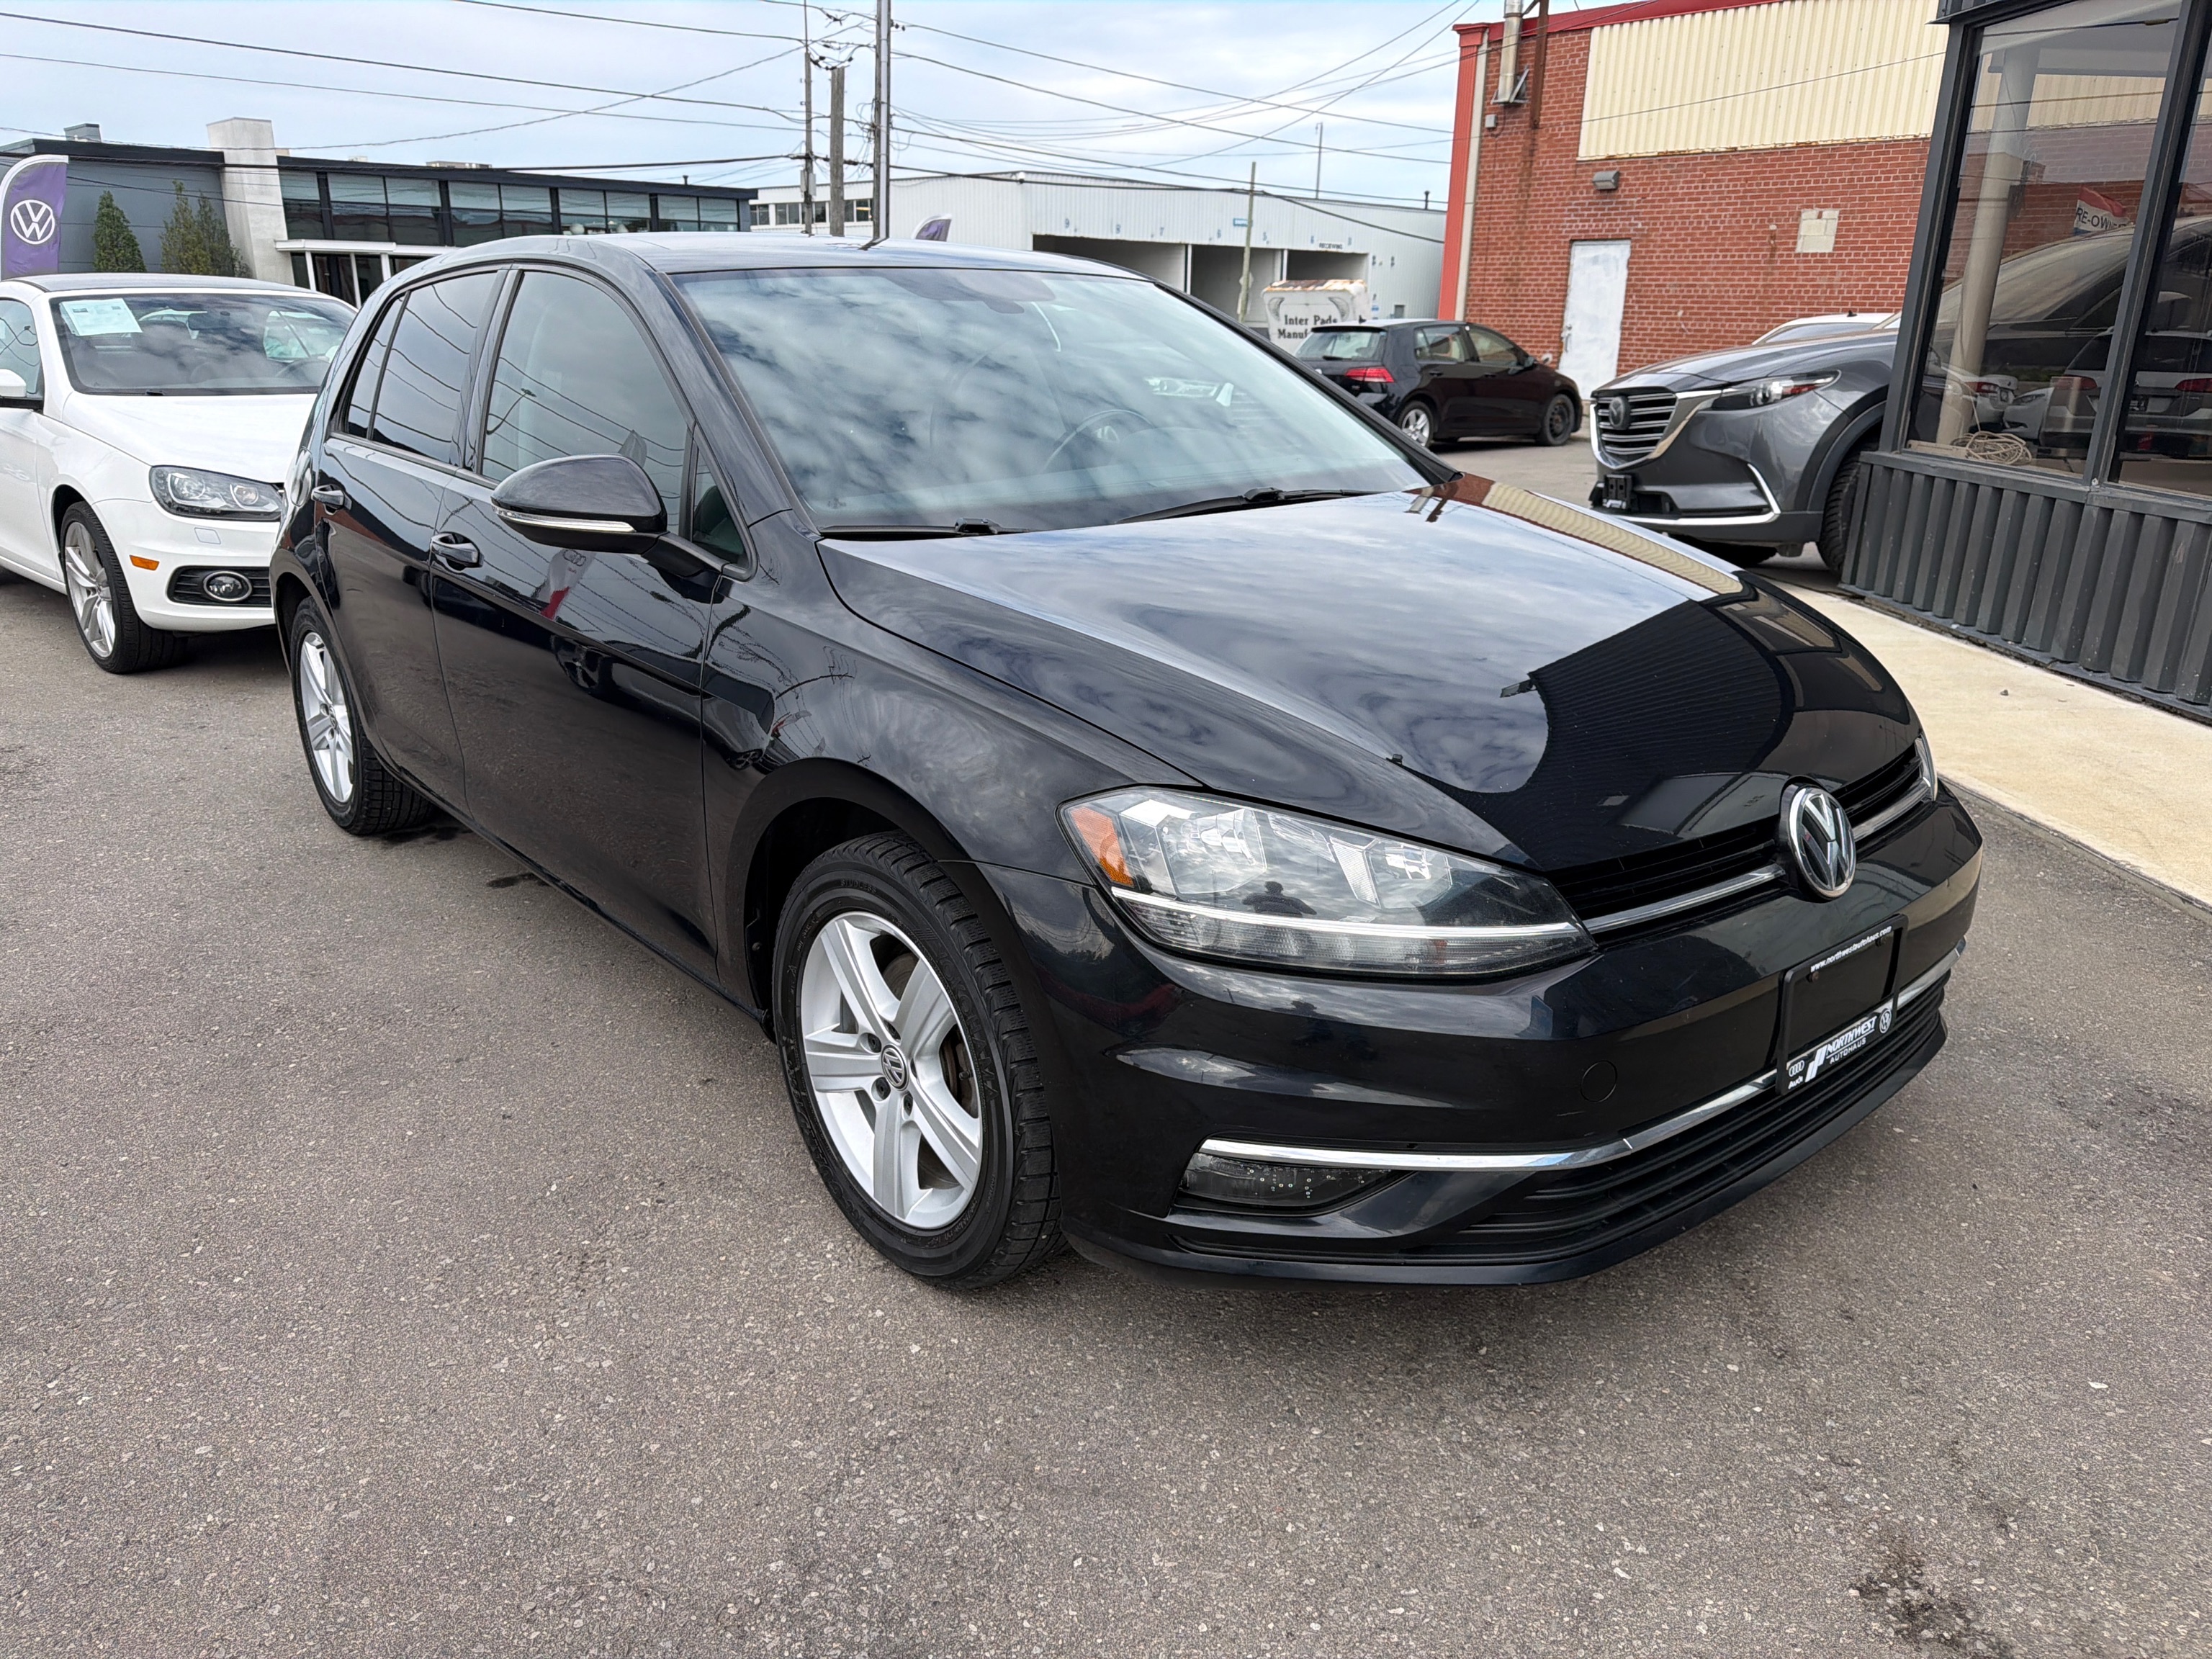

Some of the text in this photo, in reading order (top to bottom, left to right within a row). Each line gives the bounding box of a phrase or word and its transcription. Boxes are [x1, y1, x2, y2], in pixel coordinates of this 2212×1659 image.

[1285, 314, 1308, 325] Inter
[1825, 1015, 1877, 1056] NORTHWEST
[1830, 1037, 1866, 1064] AUTOHAUS
